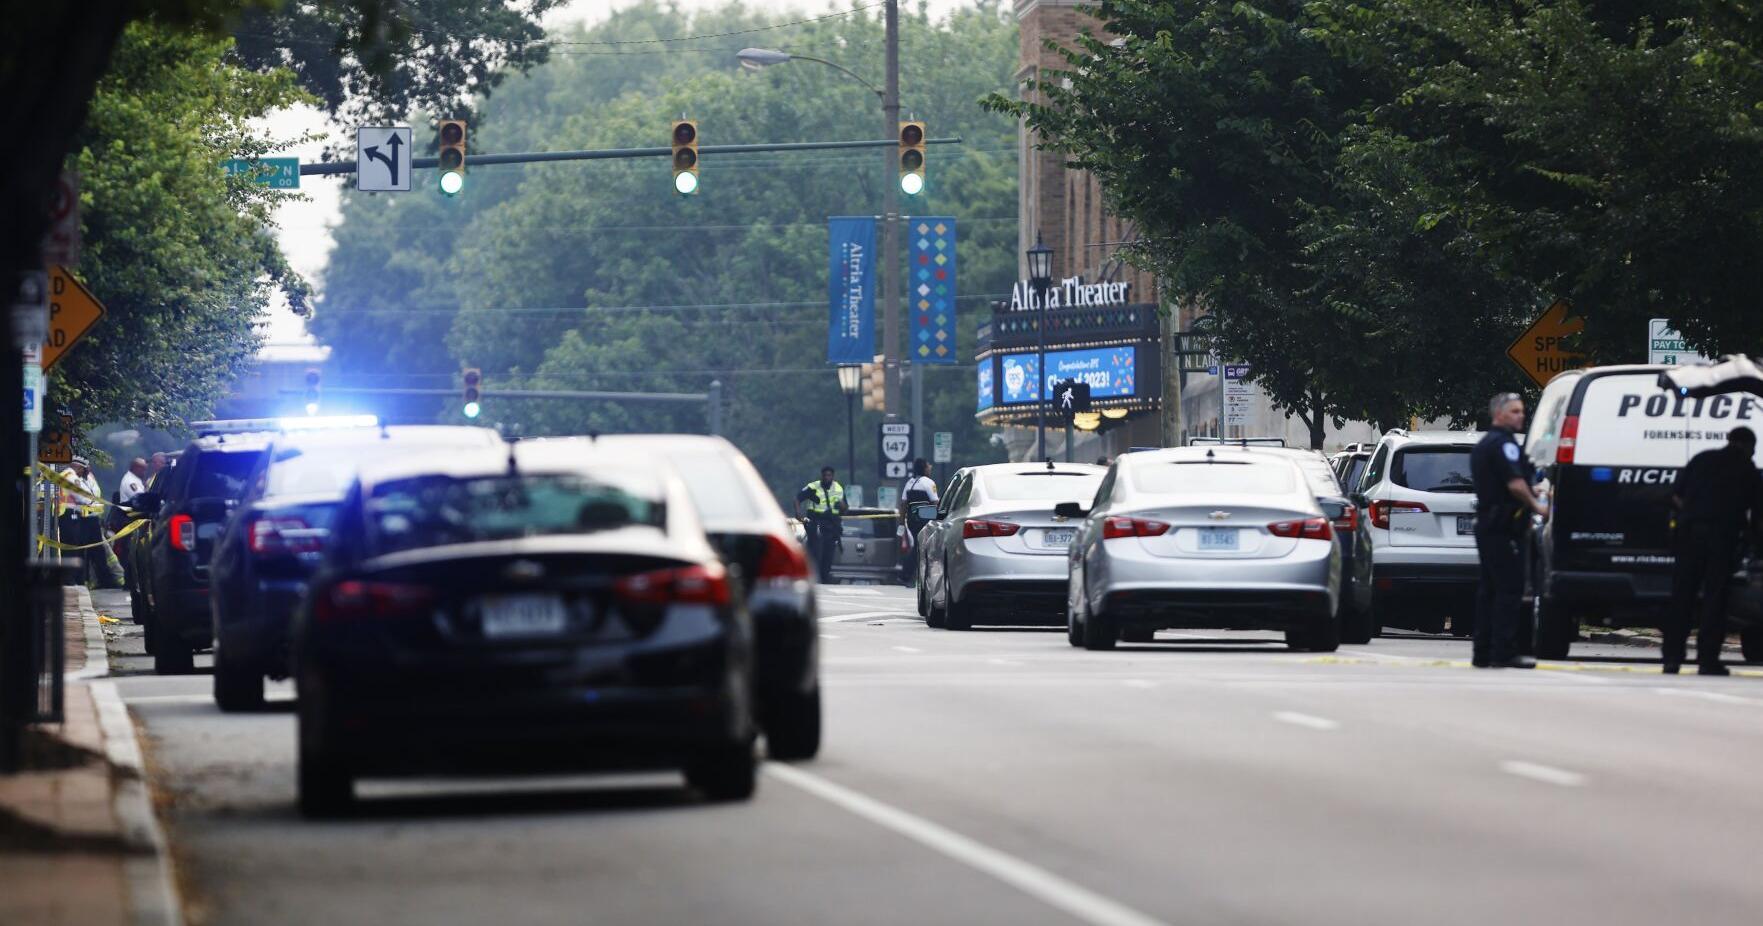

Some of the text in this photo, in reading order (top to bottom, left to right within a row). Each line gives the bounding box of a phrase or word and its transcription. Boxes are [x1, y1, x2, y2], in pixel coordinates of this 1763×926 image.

[849, 242, 863, 339] Altria Theater
[1061, 276, 1128, 307] Theater
[1654, 341, 1671, 349] PAY
[1184, 355, 1192, 368] N
[1617, 394, 1755, 420] POLICE
[1644, 429, 1702, 440] FORENSICS
[886, 441, 906, 452] 147
